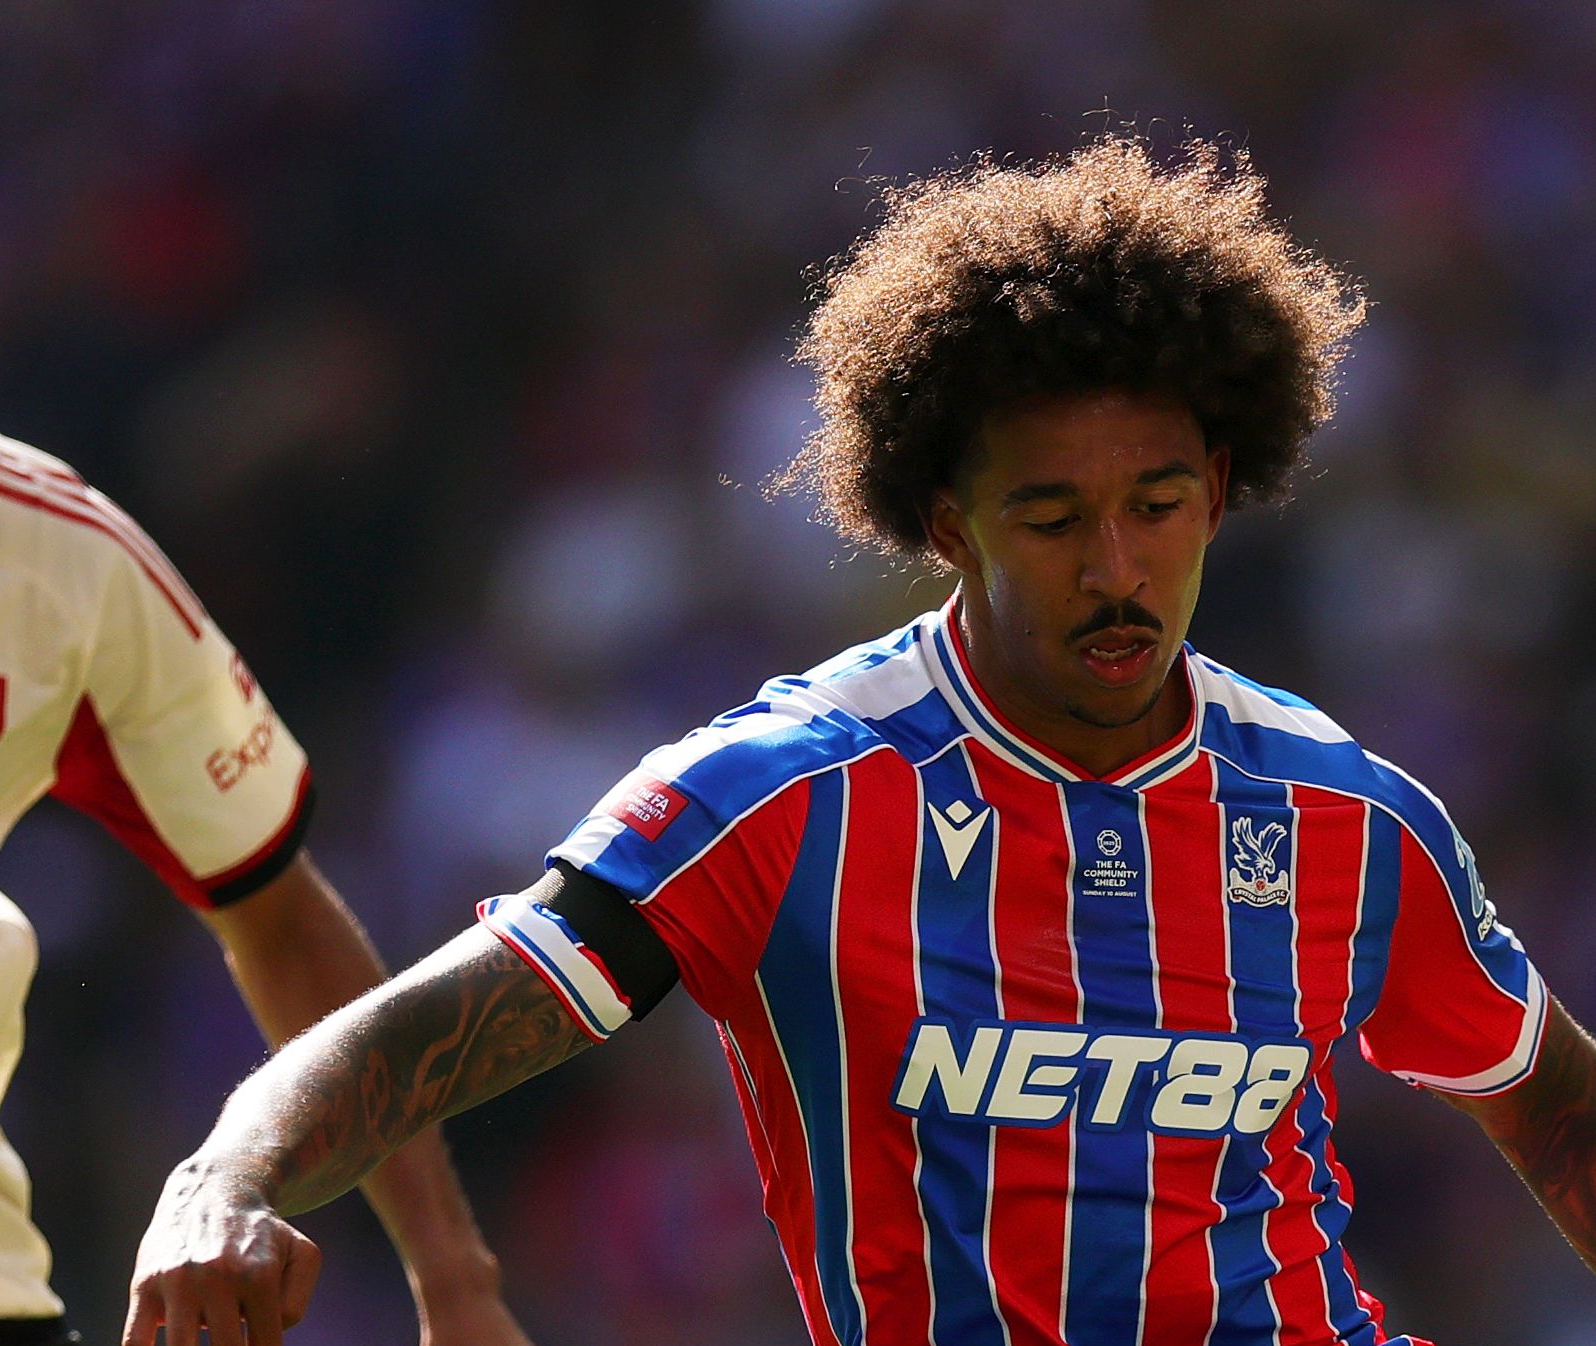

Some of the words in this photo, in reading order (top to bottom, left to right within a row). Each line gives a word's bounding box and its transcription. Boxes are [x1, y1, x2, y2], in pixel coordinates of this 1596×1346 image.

[629, 795, 666, 820] MMUNITY
[650, 793, 670, 812] FA
[1095, 860, 1113, 868] THE
[1114, 860, 1126, 869] FA
[1083, 869, 1138, 879] COMMUNITY
[1094, 878, 1126, 887] SHIELD
[1082, 889, 1106, 897] SUNDAY
[1114, 890, 1137, 898] AUGUST
[895, 1024, 1310, 1135] NET88
